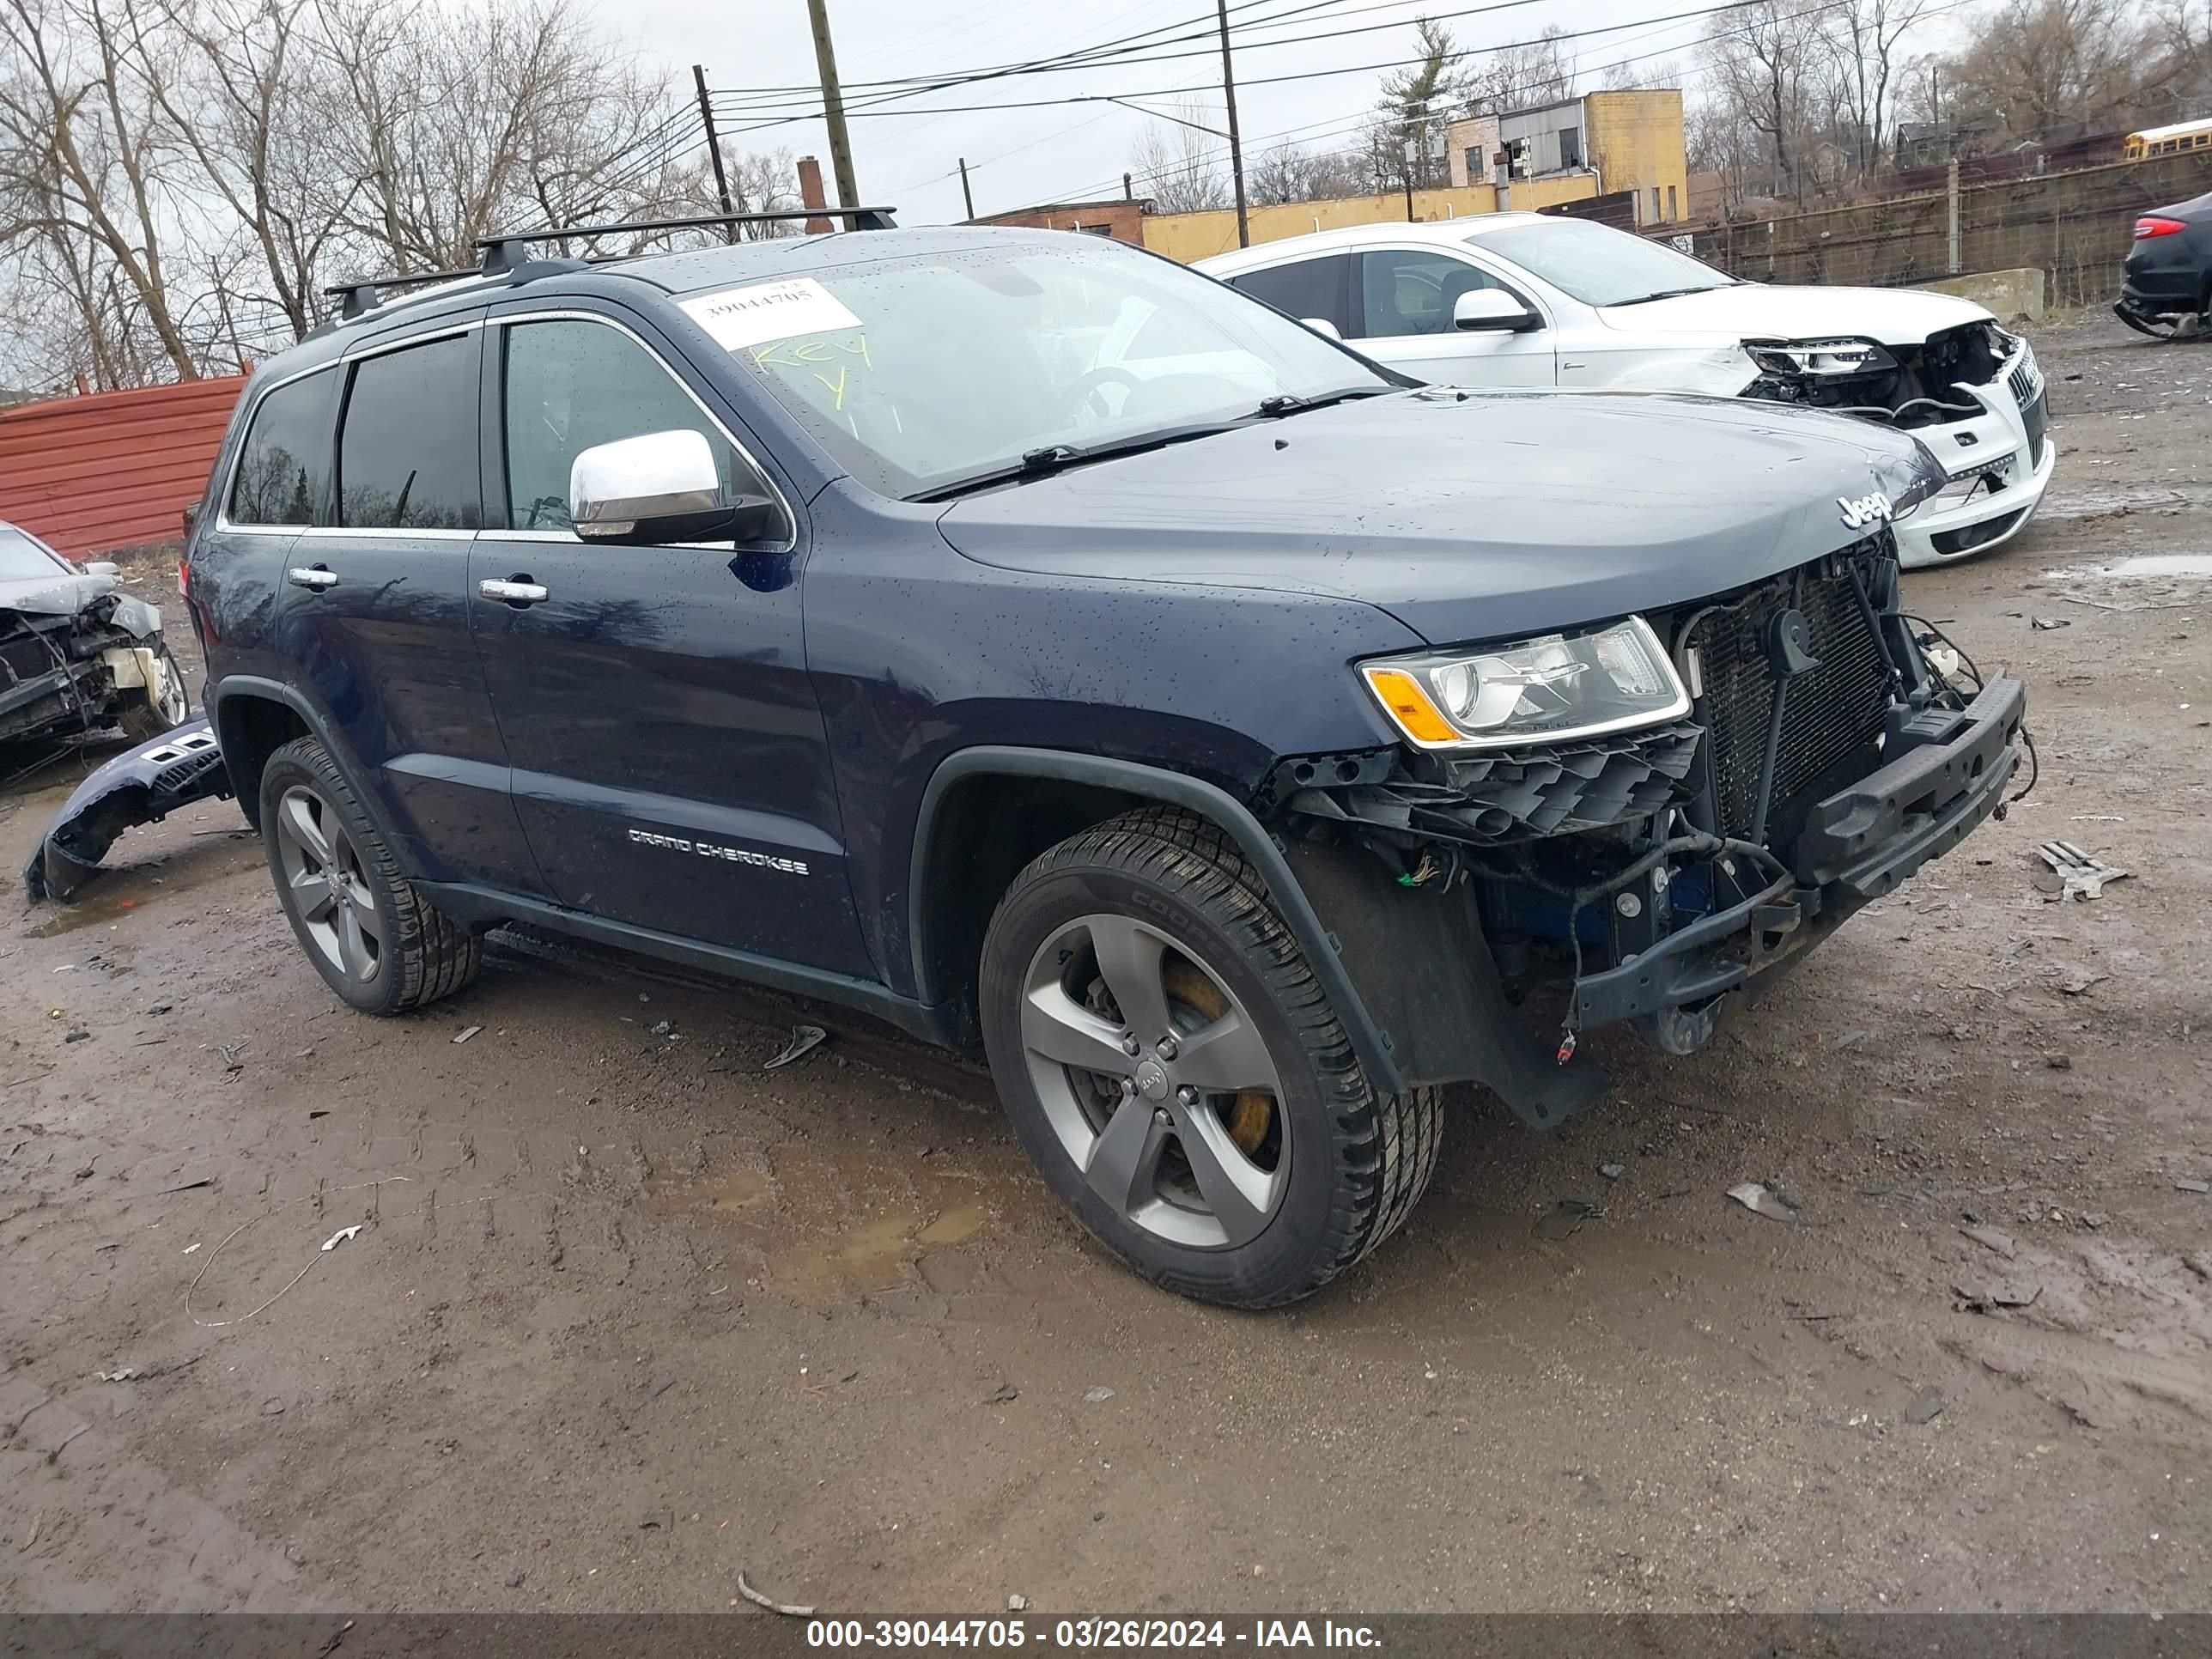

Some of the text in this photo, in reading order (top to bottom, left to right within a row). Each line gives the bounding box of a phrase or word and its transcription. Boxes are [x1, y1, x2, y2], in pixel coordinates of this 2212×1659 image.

[706, 289, 813, 319] 39044705
[1836, 490, 1893, 530] Jeep
[628, 829, 810, 876] GRAND CHEROKEE
